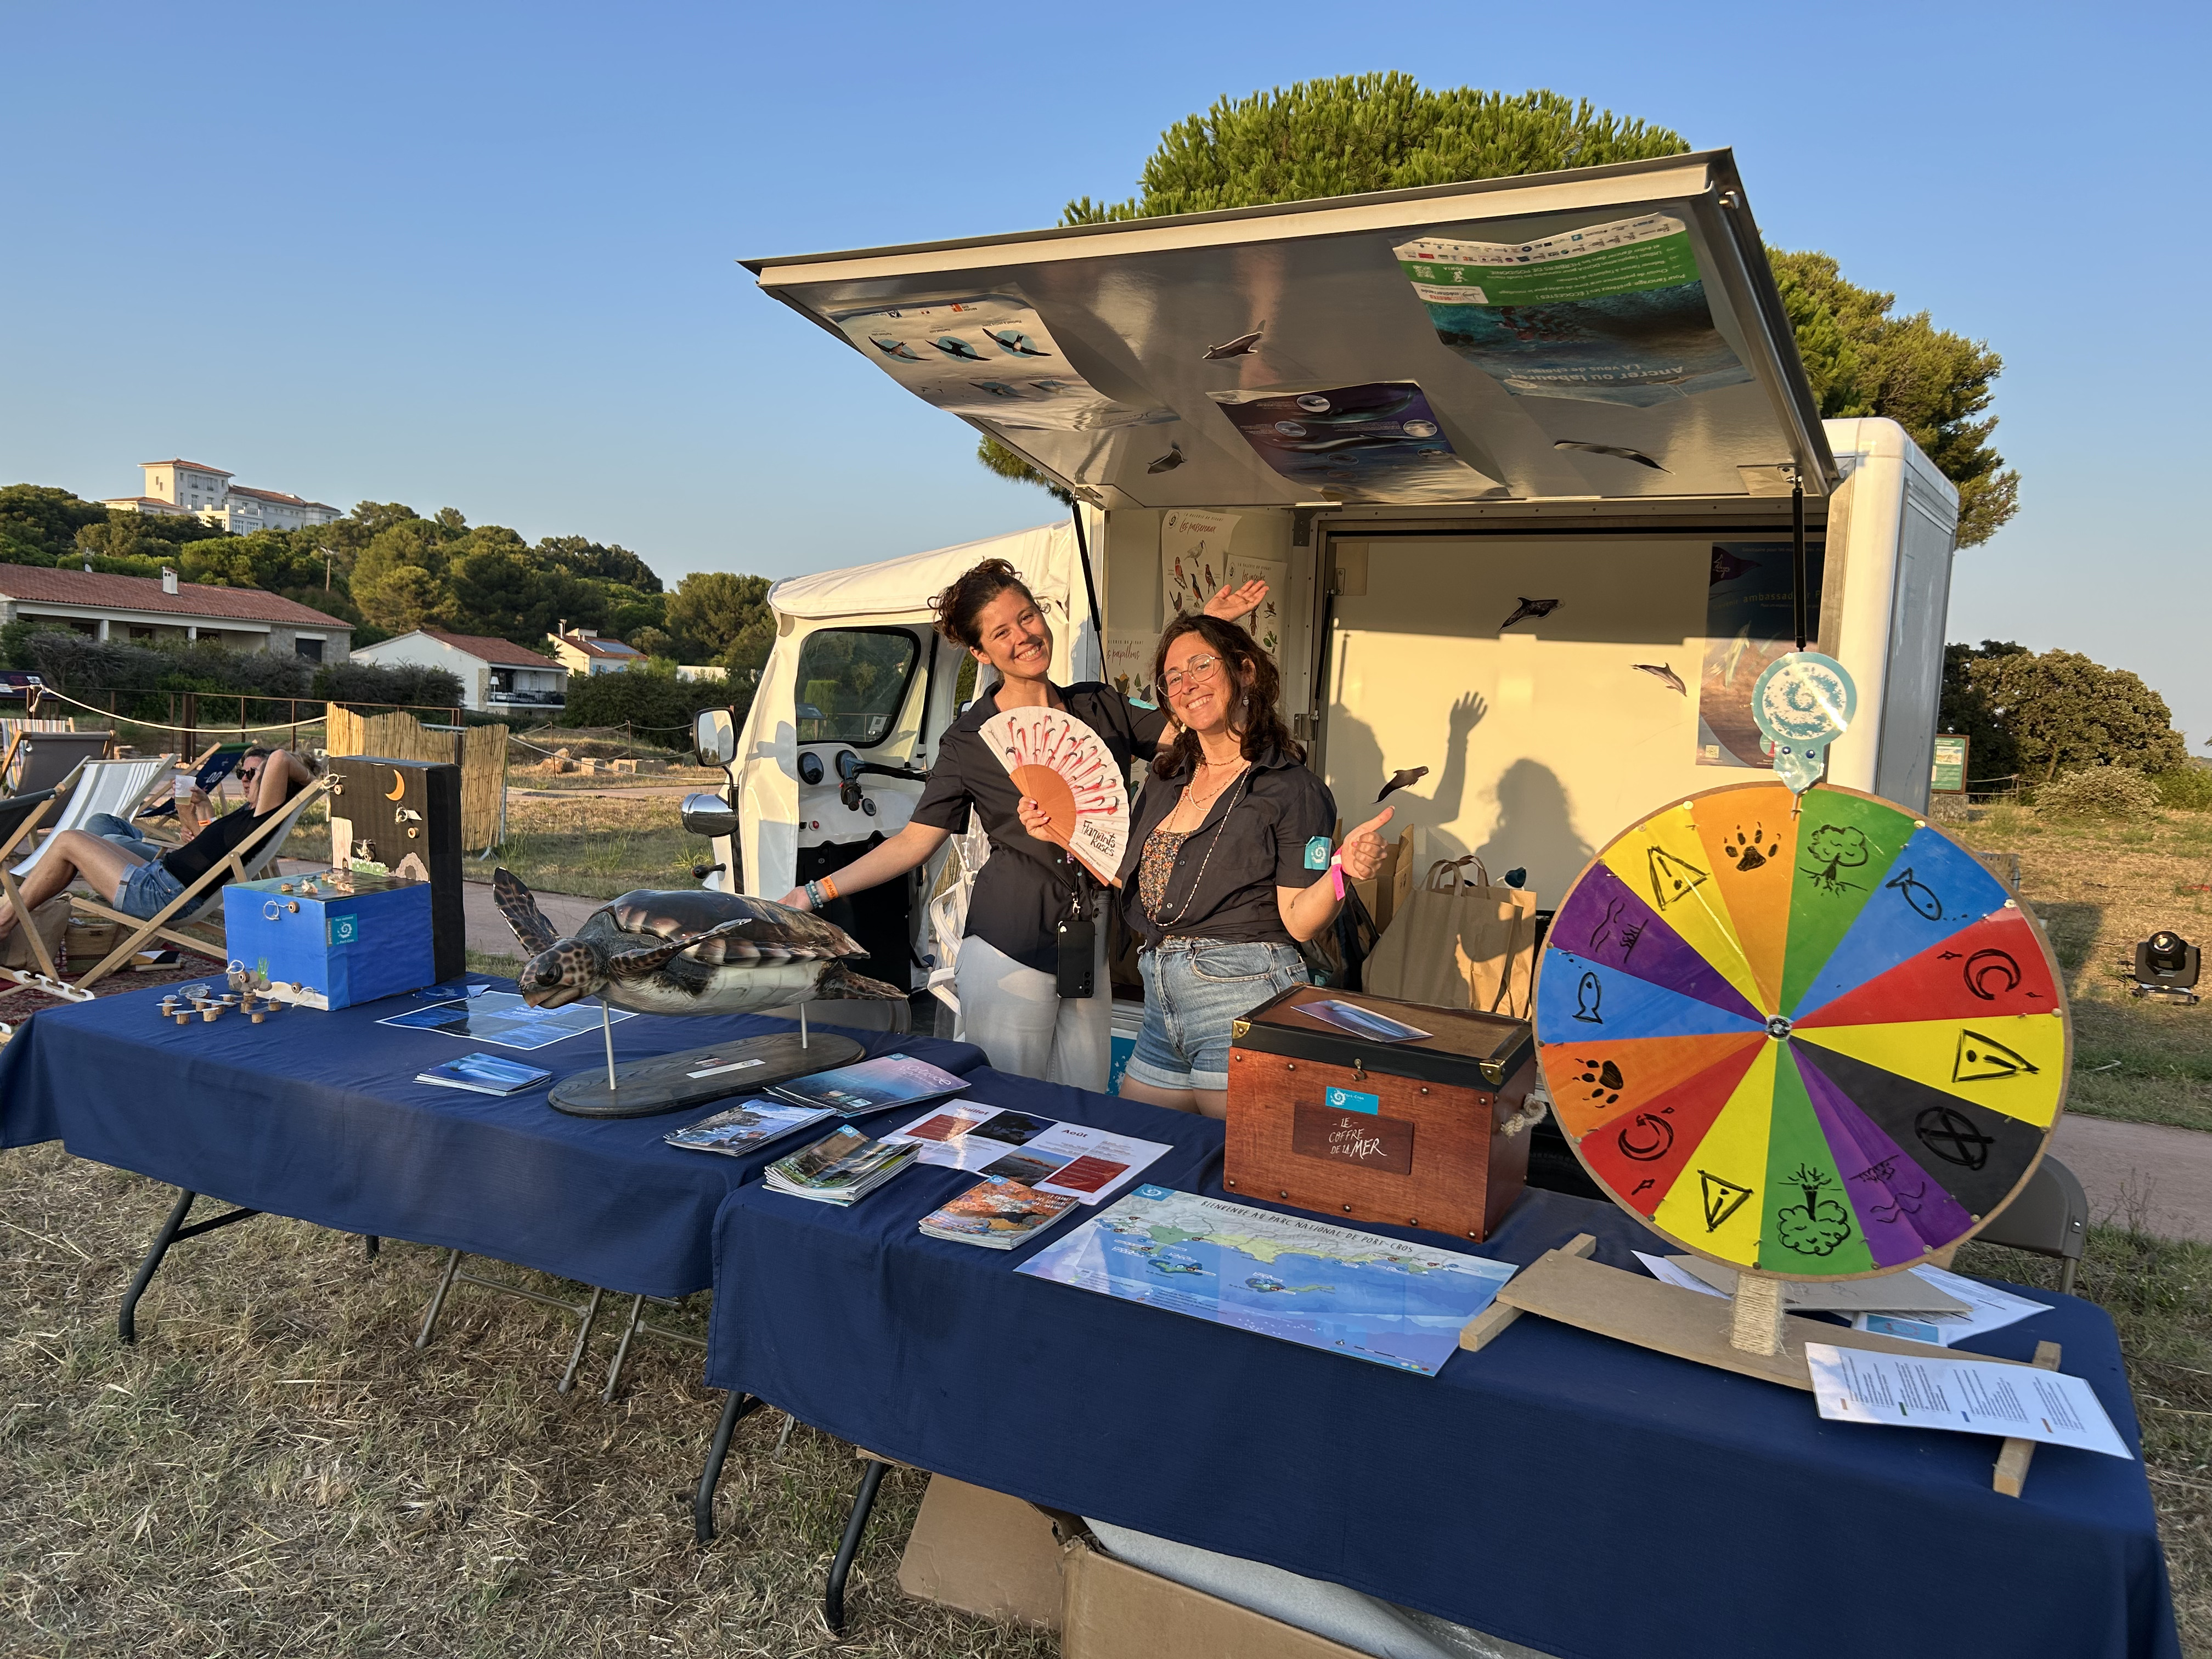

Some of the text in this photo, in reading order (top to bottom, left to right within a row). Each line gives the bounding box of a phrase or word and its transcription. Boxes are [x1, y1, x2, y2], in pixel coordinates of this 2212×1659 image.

[1620, 366, 1683, 379] Ancrer
[1180, 518, 1189, 533] Les
[1743, 591, 1810, 603] ambassadr
[1111, 641, 1140, 666] papillons
[1081, 820, 1116, 848] Flamants
[1341, 1117, 1353, 1128] LE
[1061, 1129, 1088, 1138] Août
[1329, 1128, 1364, 1143] COFFRE
[1330, 1138, 1387, 1160] DE LA MER
[1201, 1200, 1249, 1216] BIENVENUE
[1268, 1216, 1293, 1226] PARC
[1295, 1221, 1341, 1237] NATIONAL
[1361, 1237, 1414, 1253] PORT-CROS
